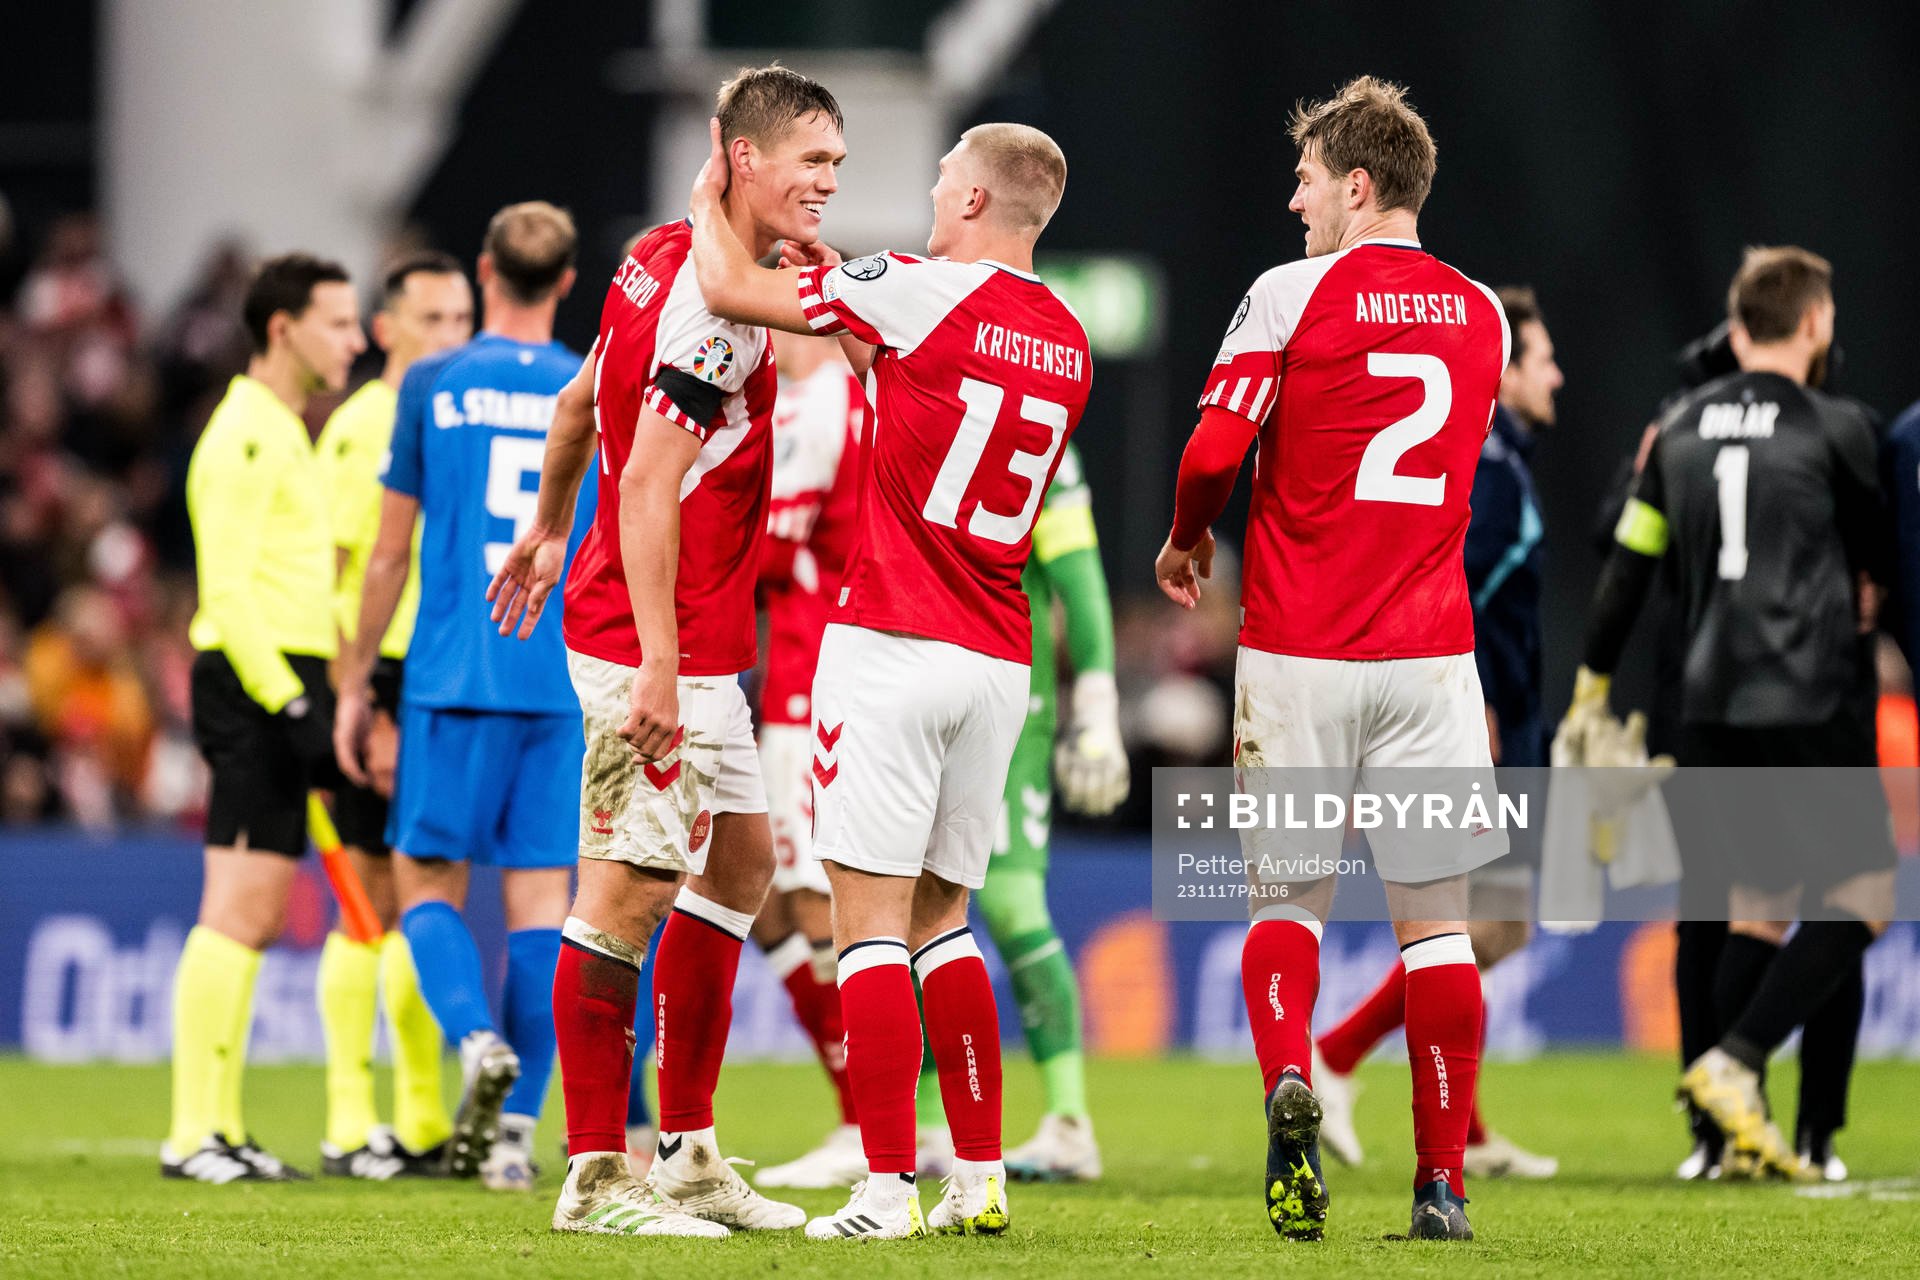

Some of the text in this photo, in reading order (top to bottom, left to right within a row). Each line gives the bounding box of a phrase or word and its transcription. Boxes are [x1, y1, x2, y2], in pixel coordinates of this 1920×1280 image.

[1356, 292, 1467, 325] ANDERSEN
[974, 321, 1083, 382] KRISTENSEN
[922, 377, 1069, 545] 13
[1355, 352, 1452, 506] 2
[484, 434, 547, 576] 5
[1713, 445, 1750, 580] 1
[658, 993, 666, 1070] DANMARK
[1269, 973, 1284, 1021] DANMARK
[962, 1034, 983, 1102] DANMARK
[1430, 1045, 1449, 1109] DANMARK
